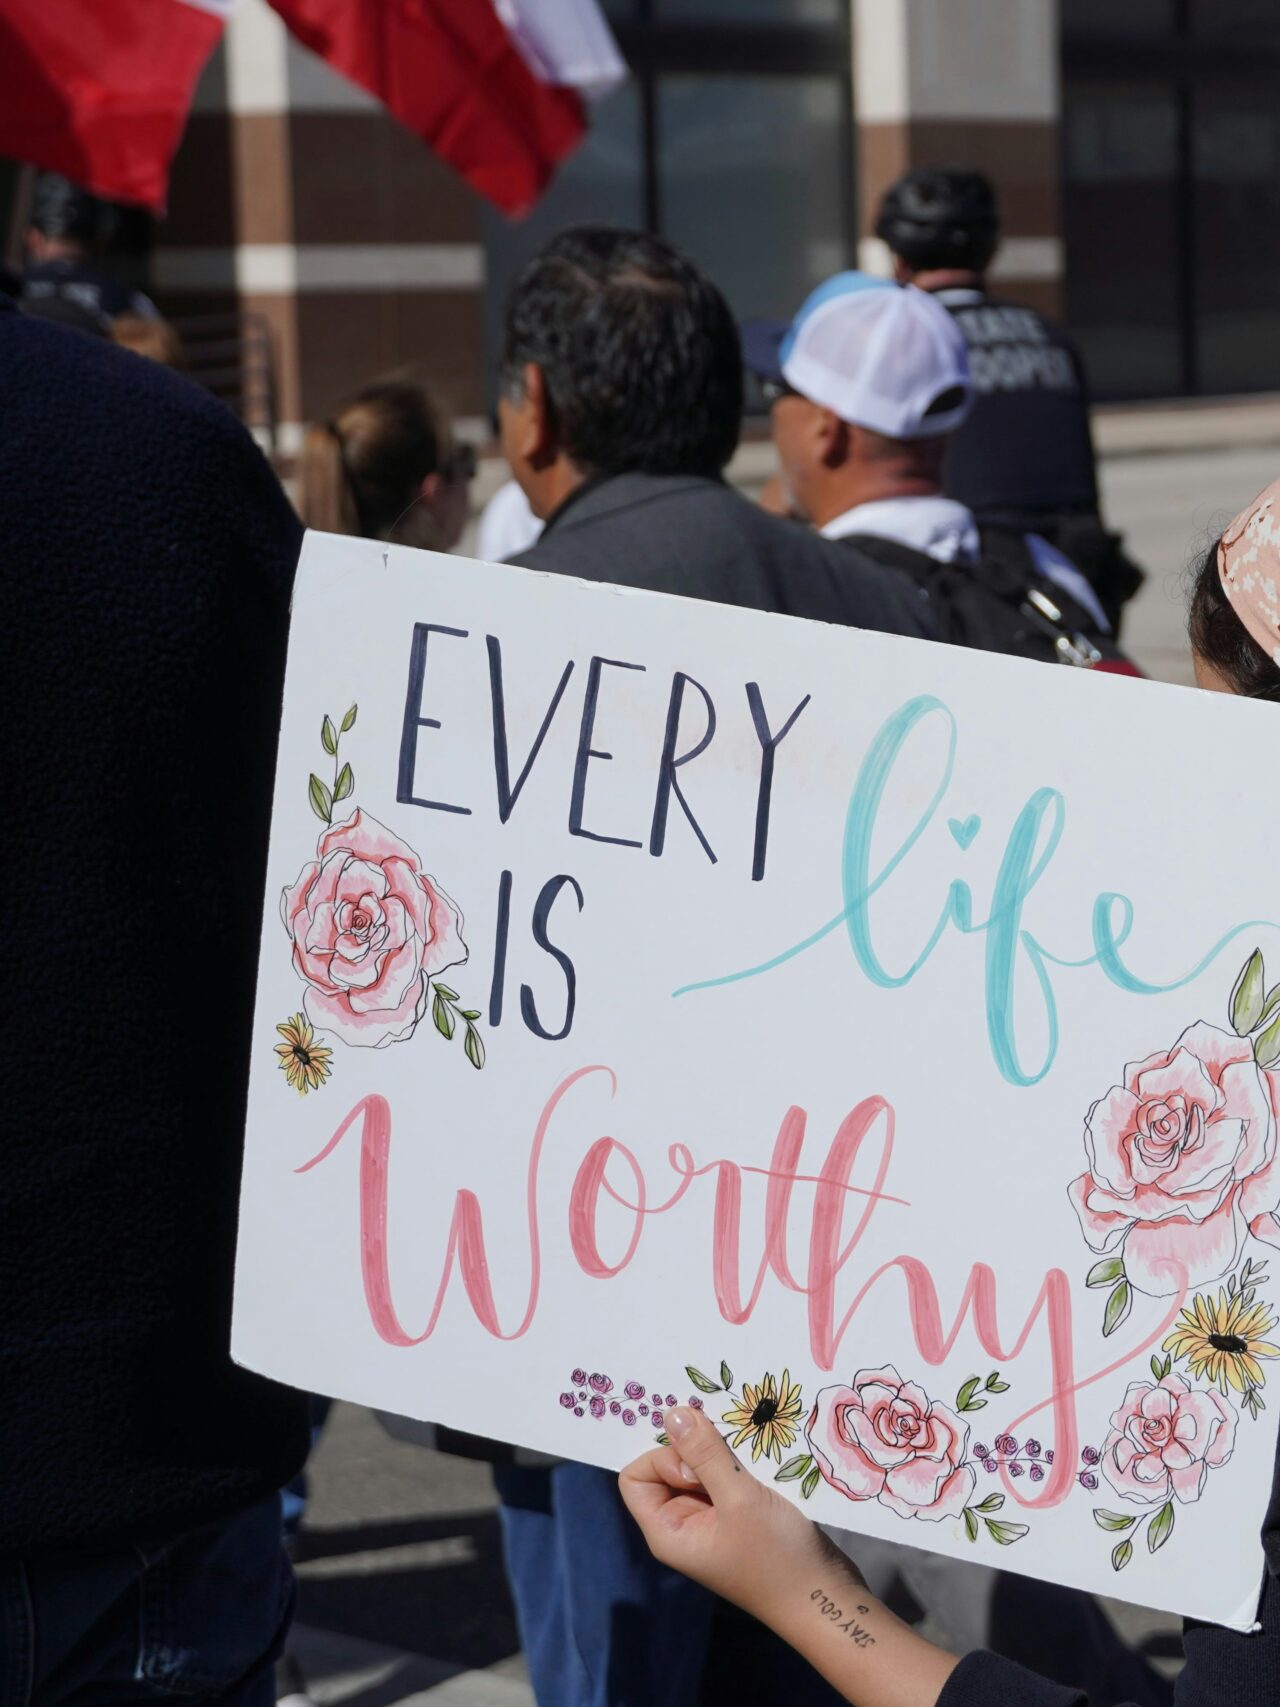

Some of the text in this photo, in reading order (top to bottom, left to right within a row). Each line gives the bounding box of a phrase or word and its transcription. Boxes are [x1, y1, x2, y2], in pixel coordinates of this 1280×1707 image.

[396, 621, 812, 882] EVERY
[489, 869, 585, 1041] IS
[293, 1065, 1190, 1510] Worthy
[810, 1589, 876, 1648] STAY GOLD
